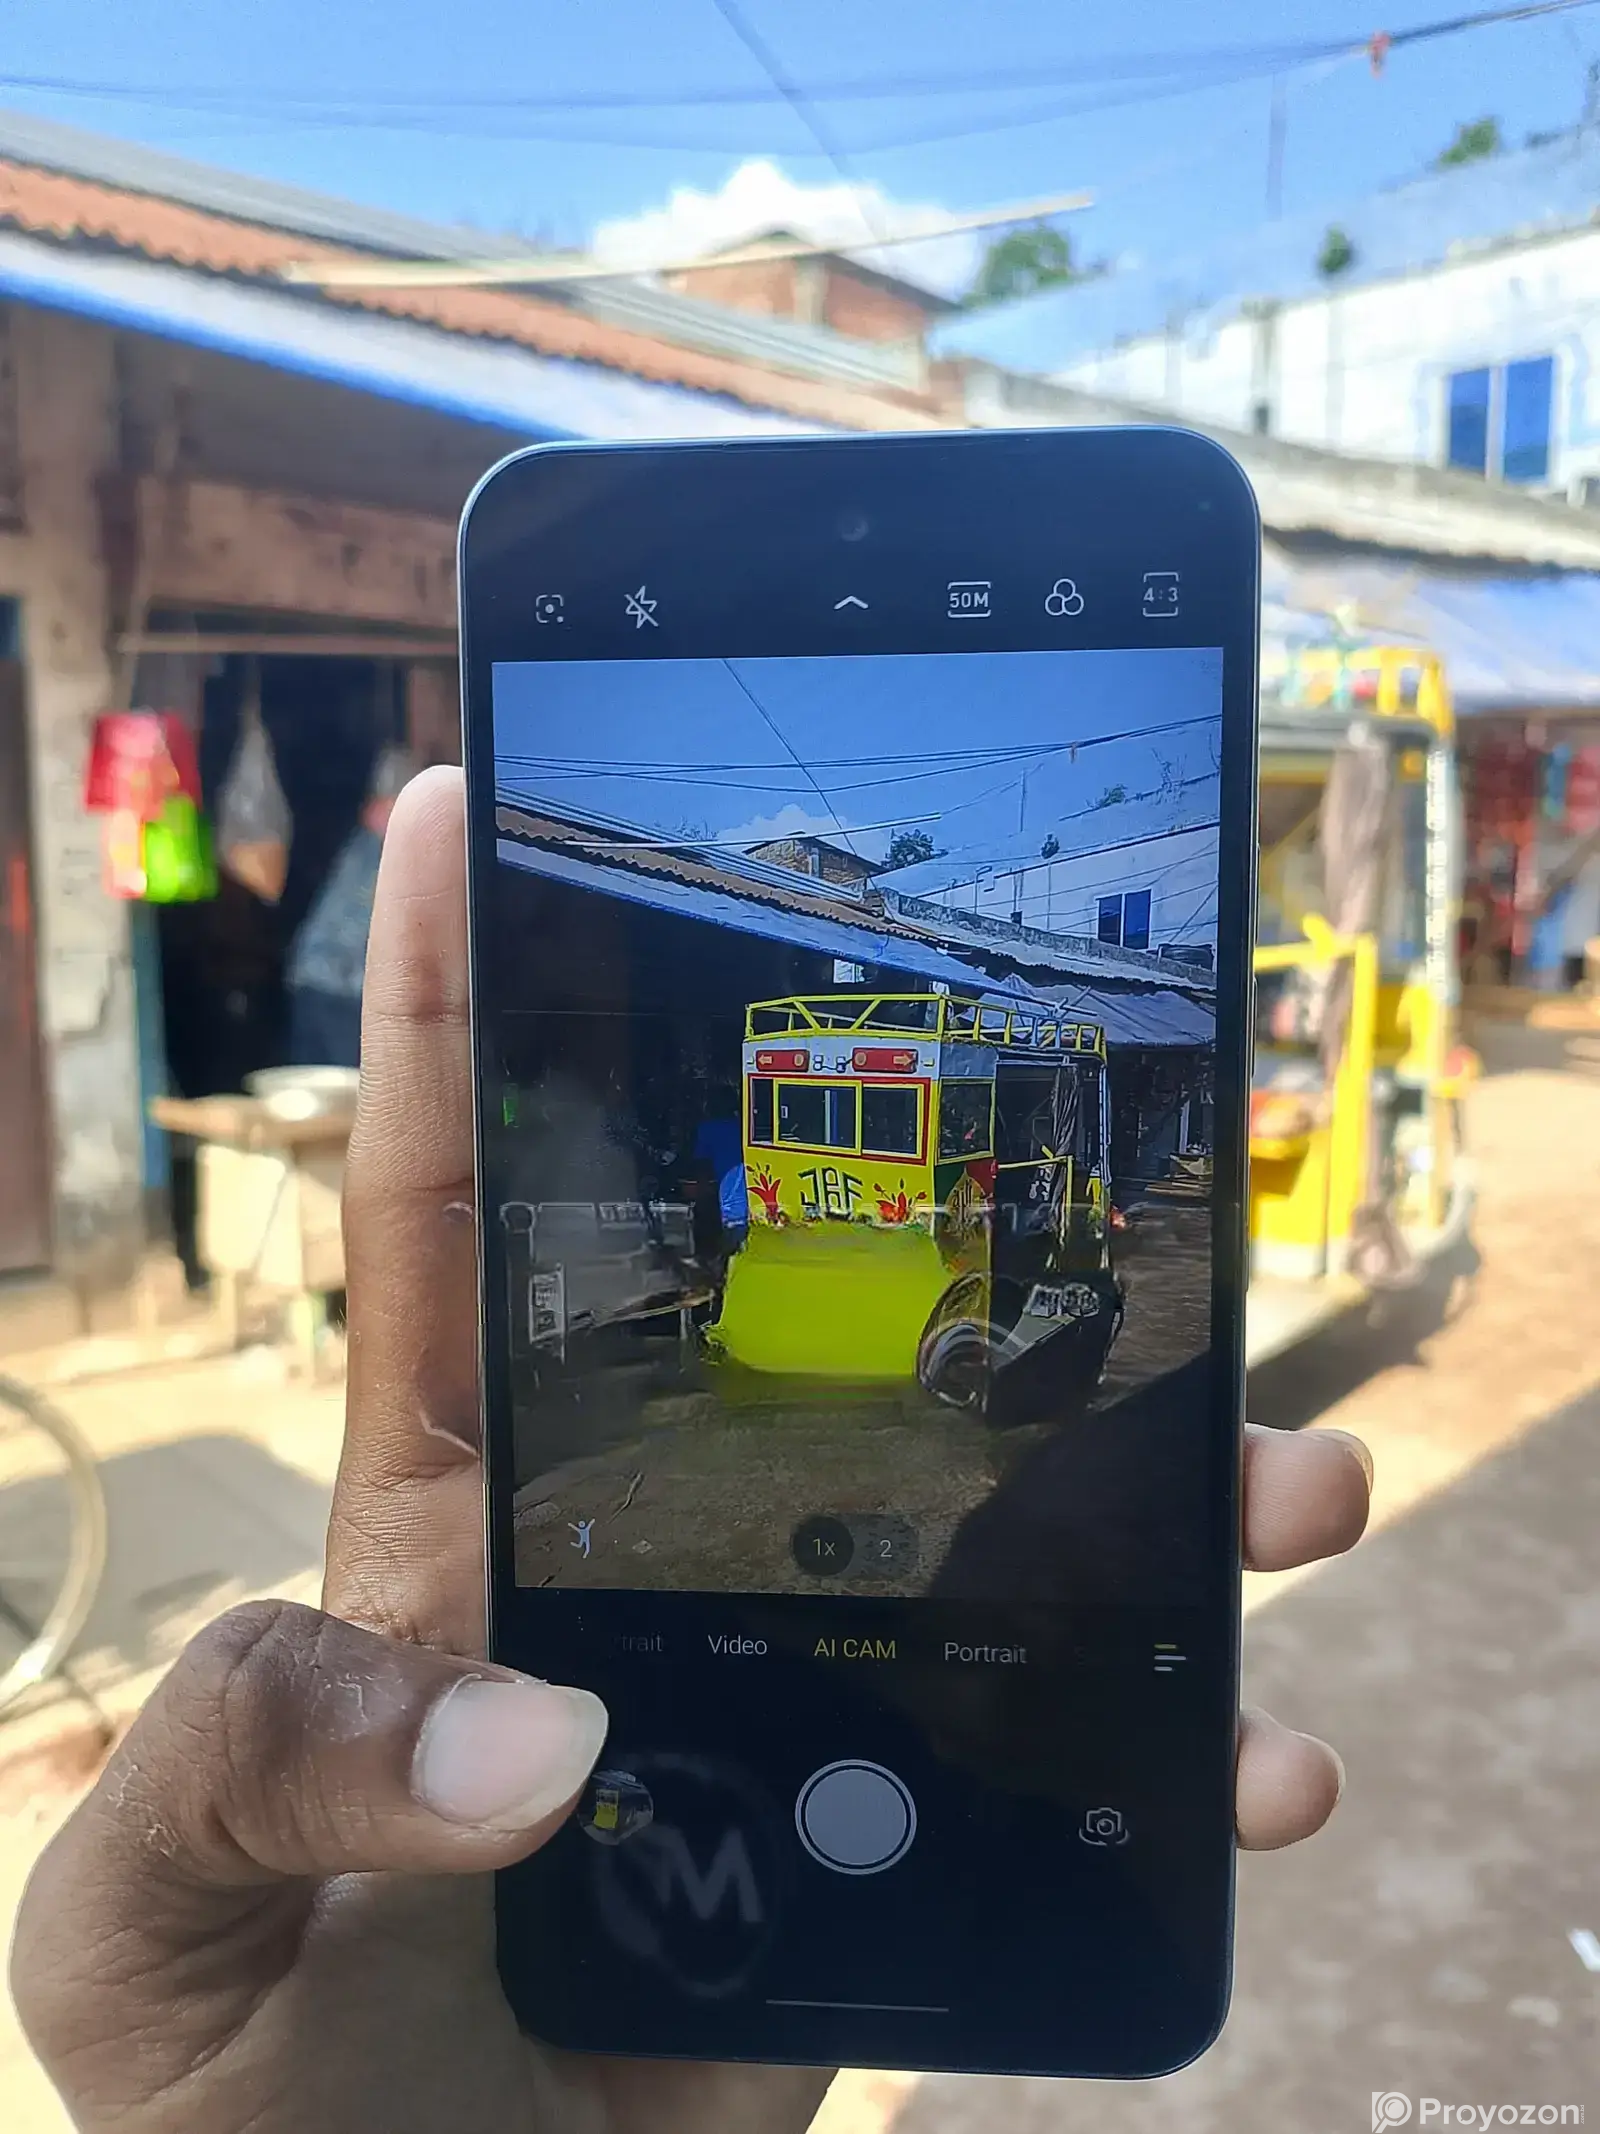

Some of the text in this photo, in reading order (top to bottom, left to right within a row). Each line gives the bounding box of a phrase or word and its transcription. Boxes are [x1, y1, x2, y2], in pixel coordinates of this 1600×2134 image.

[949, 592, 989, 608] 50M
[1143, 587, 1178, 603] 4:3
[812, 1537, 893, 1558] 1x 2
[617, 1632, 1028, 1664] trait Video AI CAM Portrait
